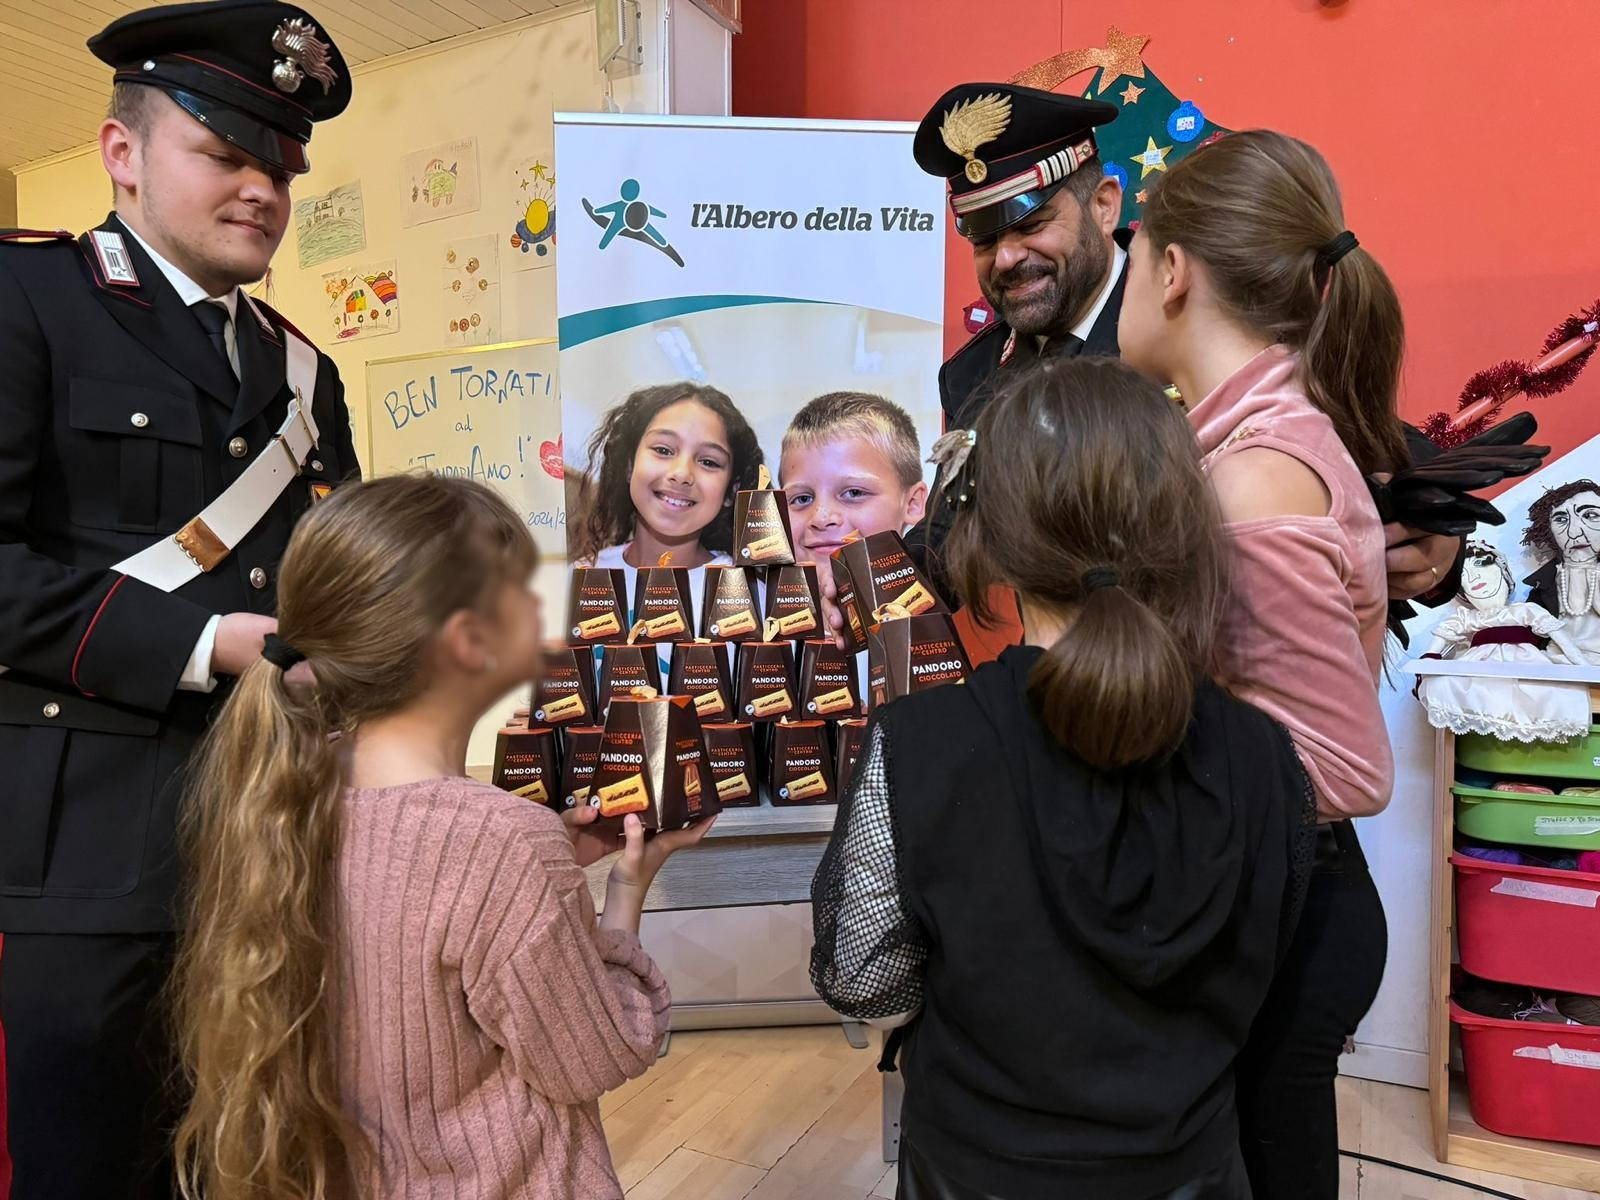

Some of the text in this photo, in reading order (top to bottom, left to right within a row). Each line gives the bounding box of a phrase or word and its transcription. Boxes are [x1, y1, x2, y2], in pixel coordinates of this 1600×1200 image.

[691, 203, 934, 231] l'Albero della Vita
[384, 376, 438, 429] BEN
[870, 552, 906, 567] PASTICCERIA
[880, 559, 900, 568] CENTRO
[875, 567, 915, 584] PANDORO
[882, 576, 916, 590] CIOCCOLATO
[911, 642, 956, 651] PASTICCERIA
[922, 648, 947, 656] CENTRO
[912, 660, 962, 674] PANDORO
[919, 671, 962, 682] CIOCCOLATO
[601, 753, 643, 764] PANDORO
[676, 751, 700, 761] PANDORO
[603, 764, 640, 772] CIOCCOLATO
